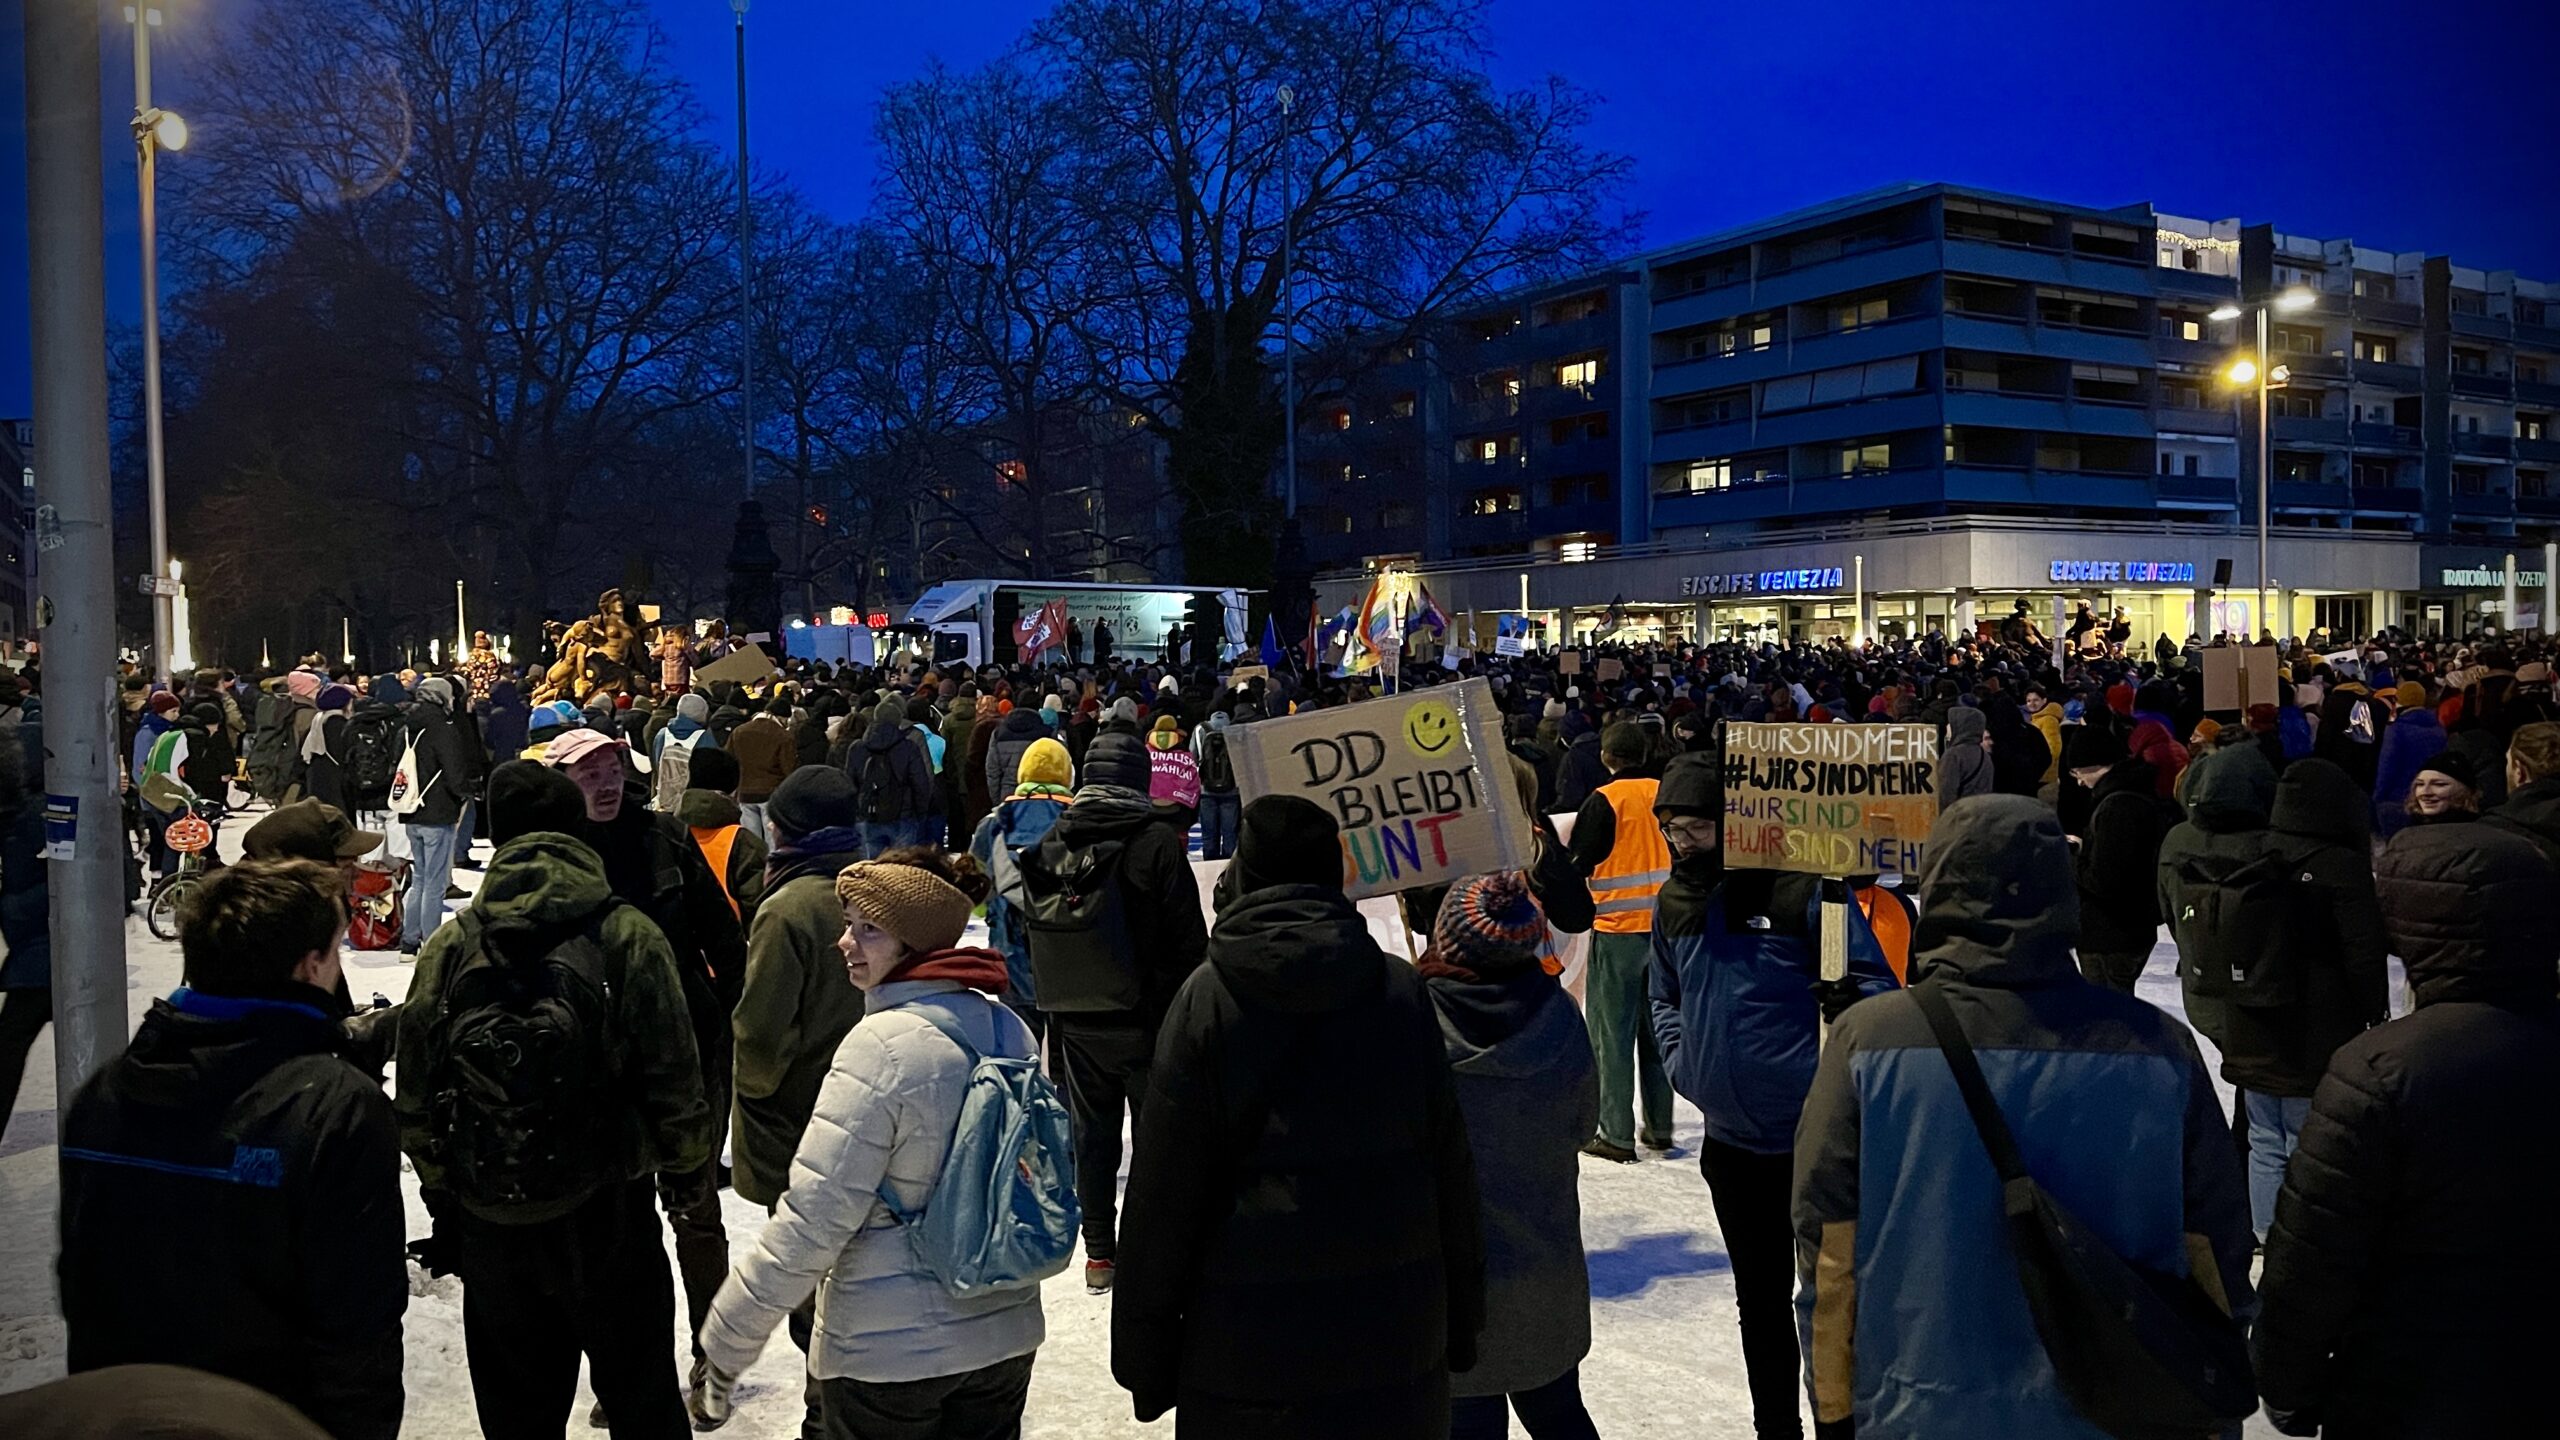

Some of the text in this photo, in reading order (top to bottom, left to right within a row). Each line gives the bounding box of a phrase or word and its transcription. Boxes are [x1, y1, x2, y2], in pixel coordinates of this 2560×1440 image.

[1760, 568, 1843, 590] VENEZIA
[2126, 562, 2195, 582] VENEZIA
[2443, 564, 2547, 587] TRATTORIA LA AZZETTA
[1291, 730, 1387, 787] DD
[1726, 727, 1940, 762] #WIRSINDMEHR
[1725, 754, 1934, 796] #WIRSINDMEHR
[1329, 764, 1478, 830] BLEIBT
[1726, 823, 1924, 876] #WIRSINDMEH
